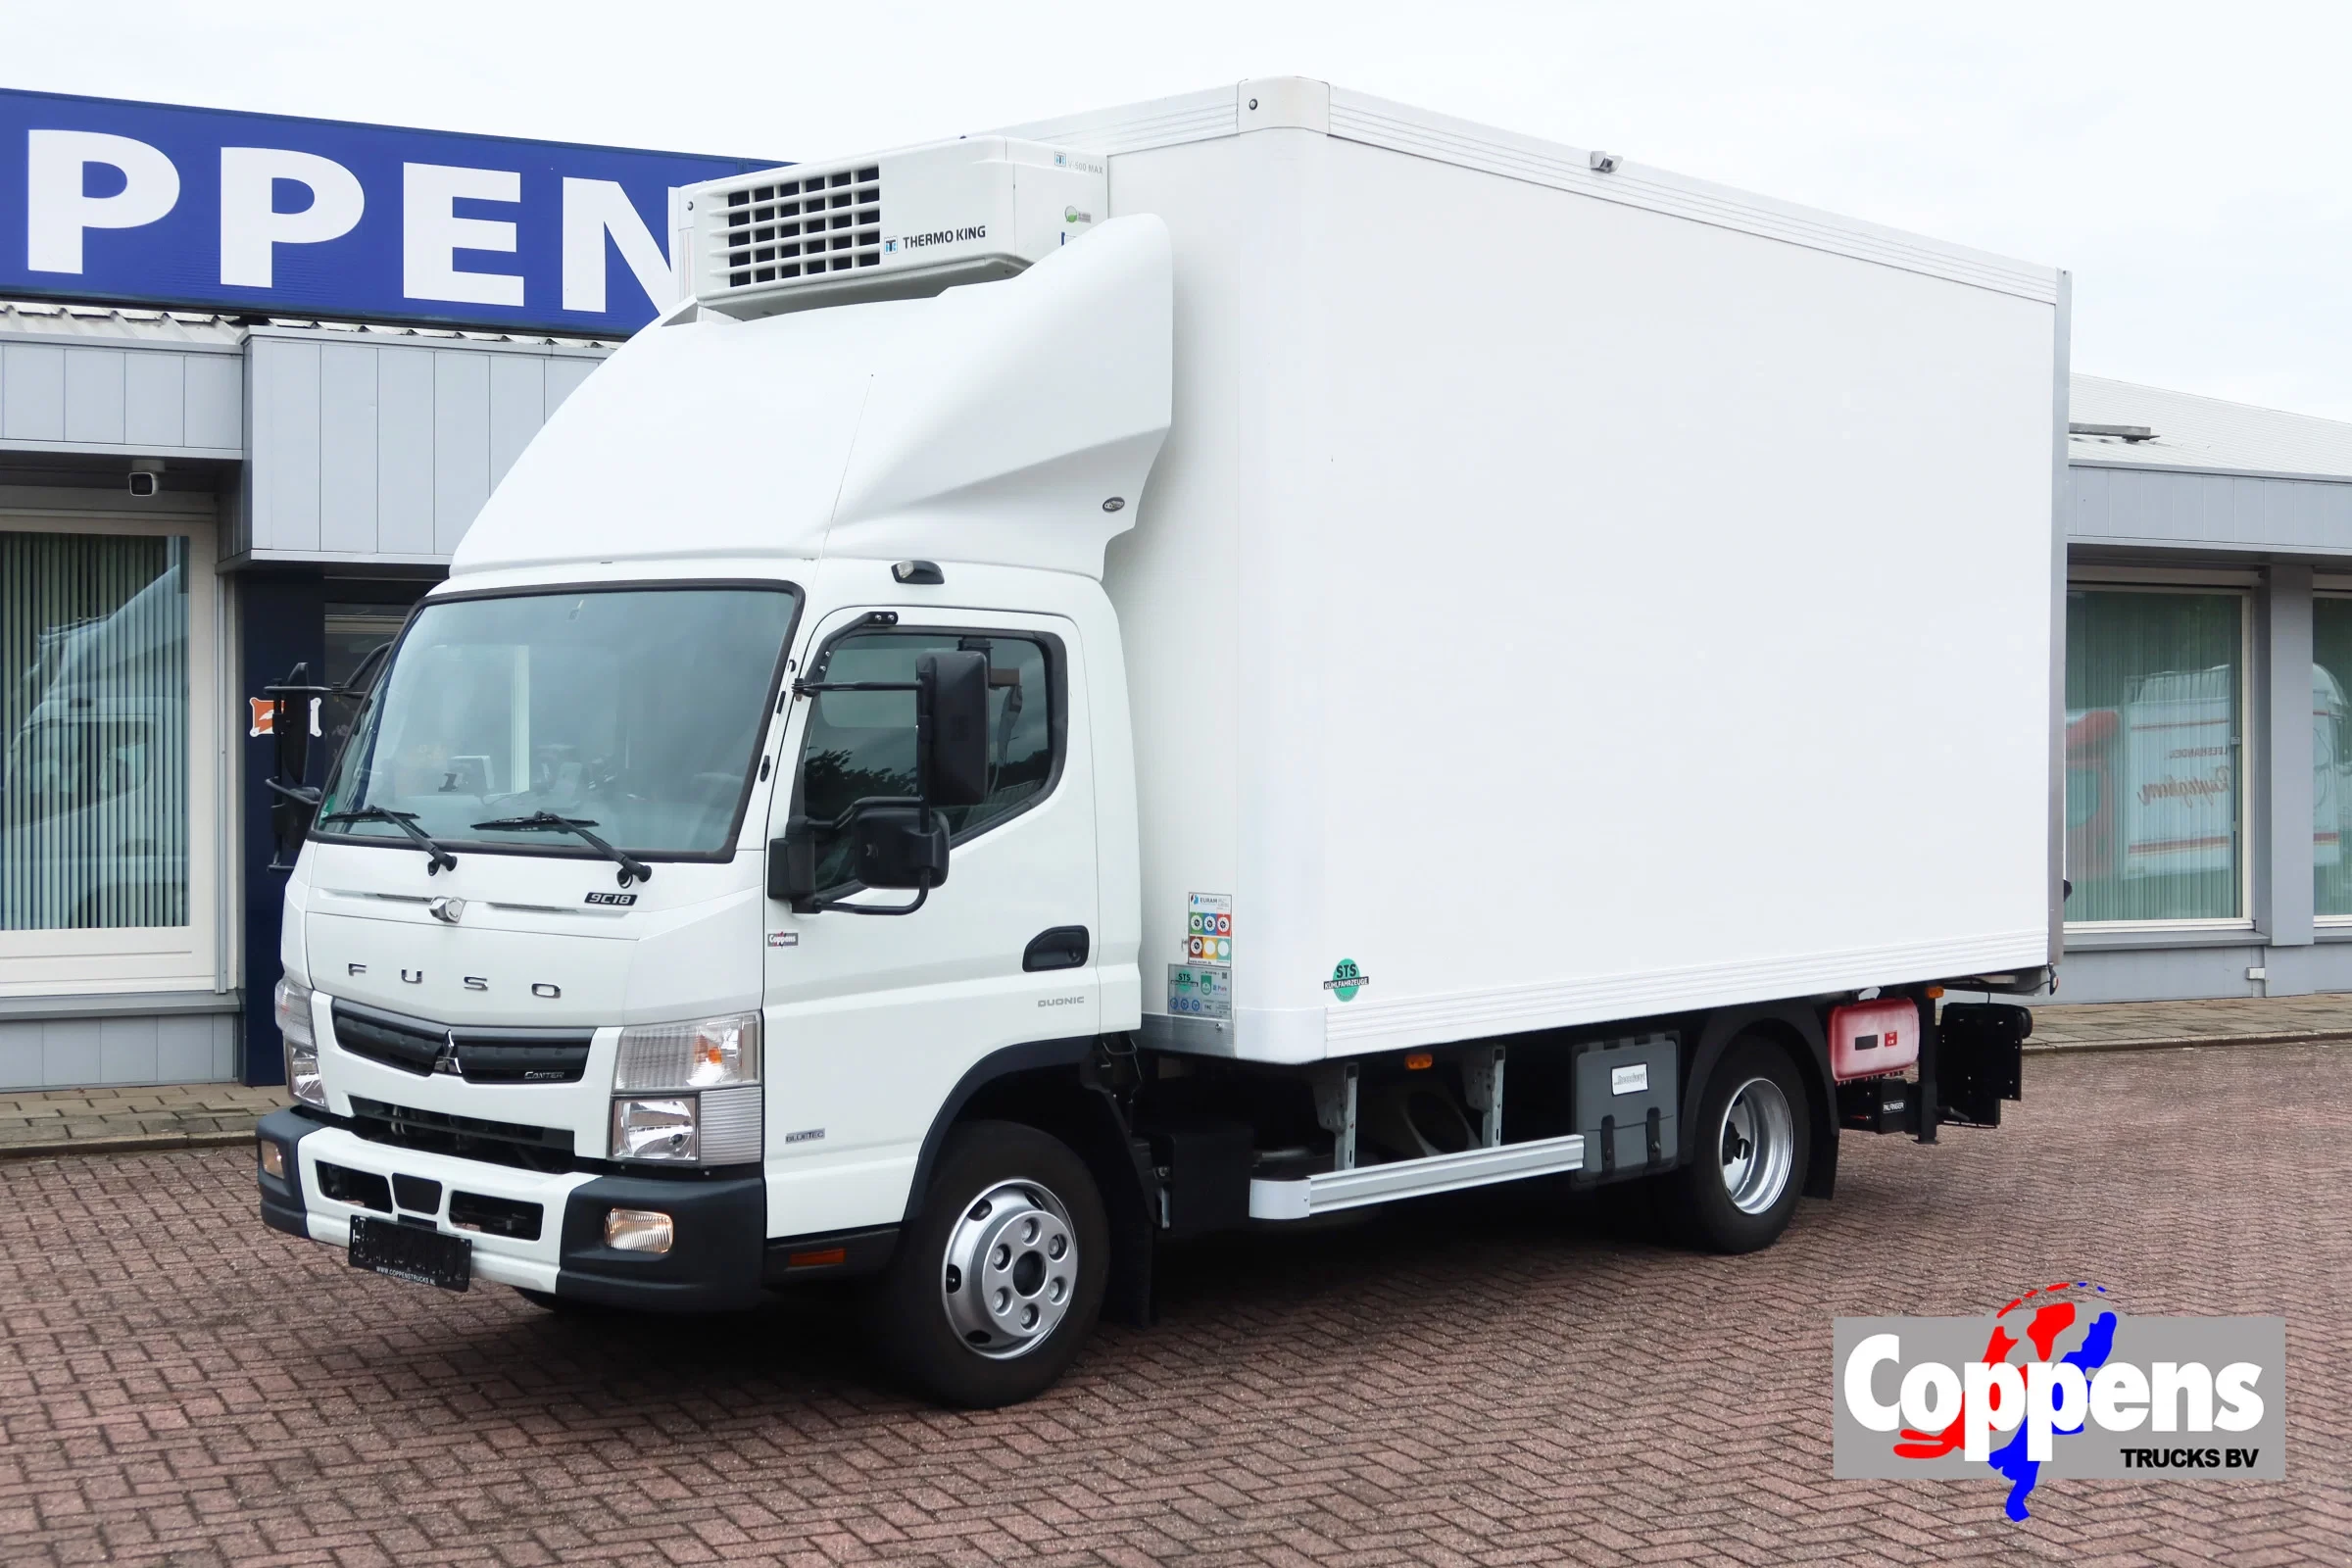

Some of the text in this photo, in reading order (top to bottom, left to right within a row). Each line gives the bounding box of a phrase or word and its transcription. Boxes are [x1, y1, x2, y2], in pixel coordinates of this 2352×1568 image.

[1088, 164, 1103, 174] MAX
[27, 128, 678, 318] PPEN
[903, 225, 986, 249] THERMO KING
[589, 893, 632, 905] 9C18
[769, 934, 796, 946] Coppens
[1336, 963, 1357, 978] STS
[348, 962, 562, 999] FUSO
[1038, 996, 1085, 1007] DUONIC
